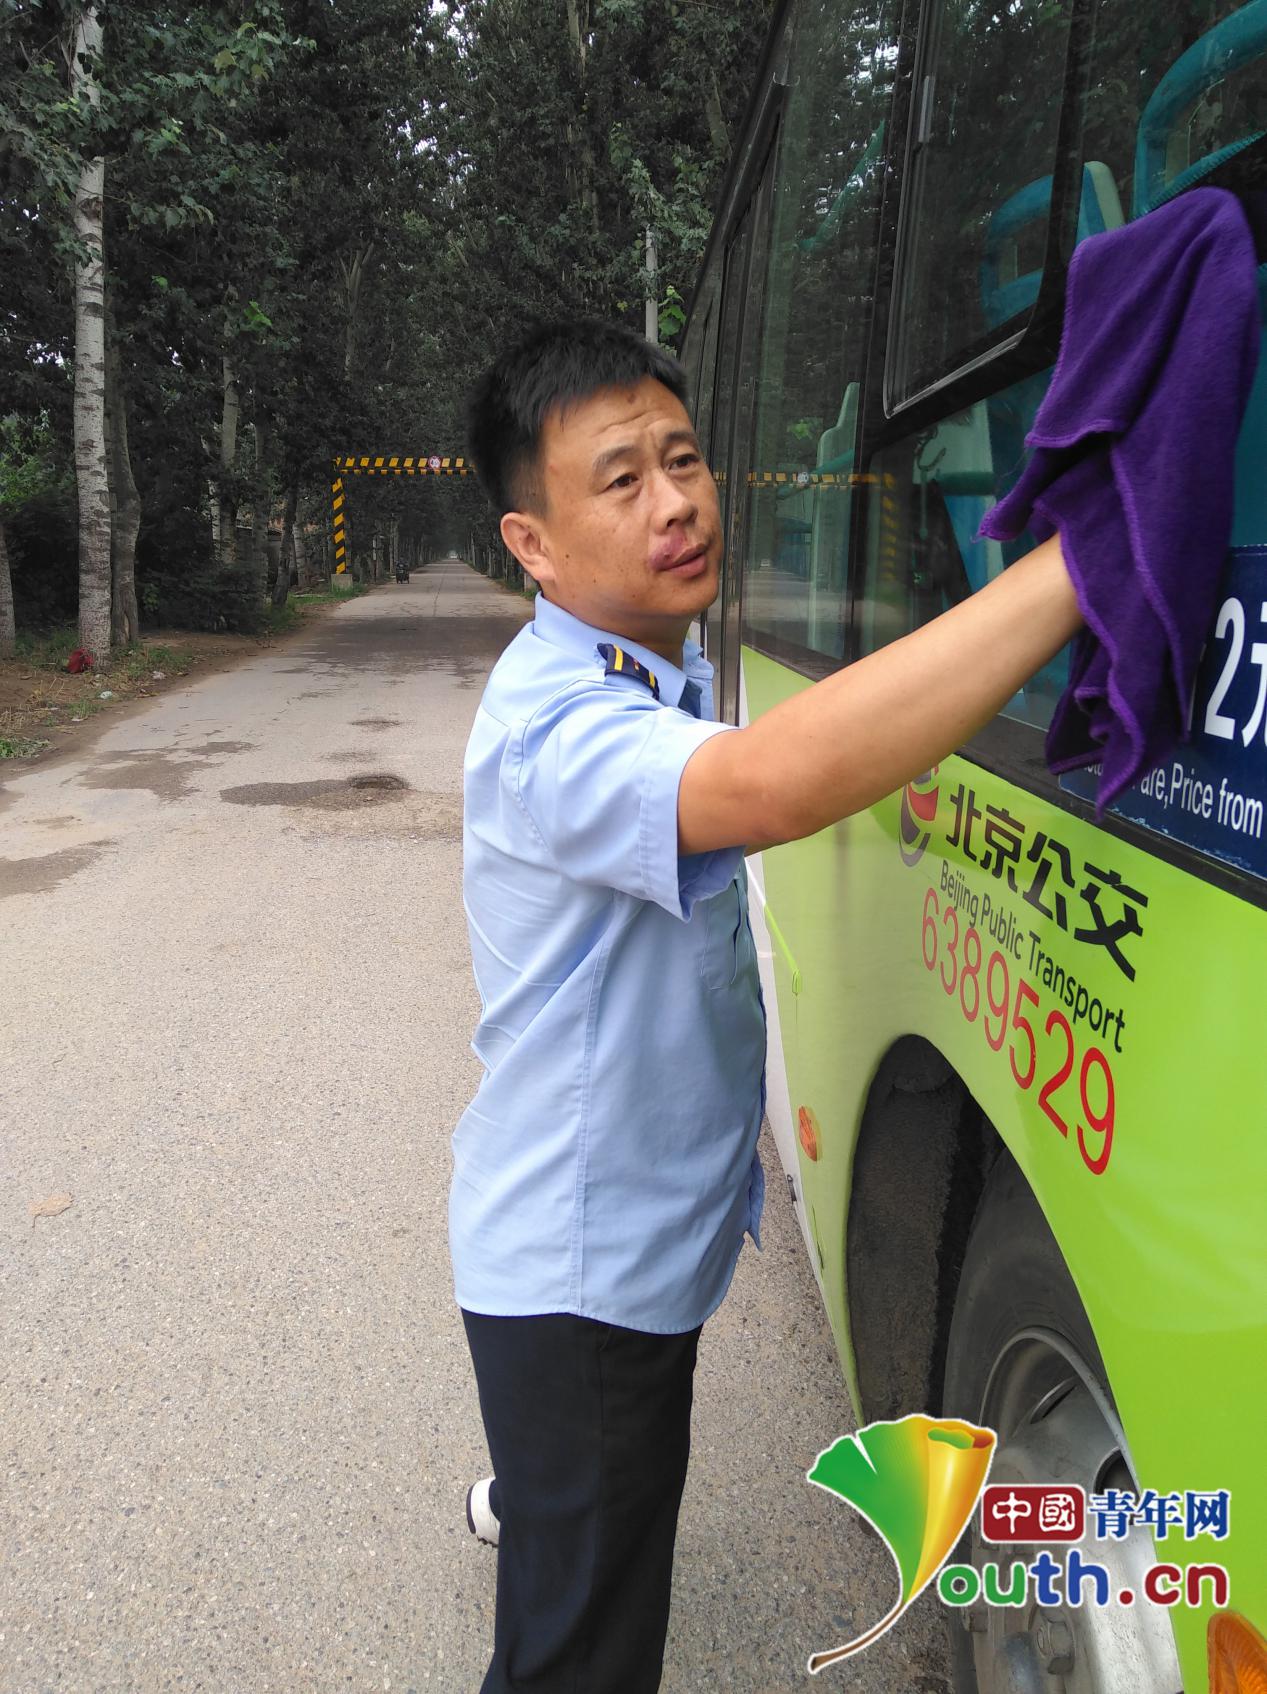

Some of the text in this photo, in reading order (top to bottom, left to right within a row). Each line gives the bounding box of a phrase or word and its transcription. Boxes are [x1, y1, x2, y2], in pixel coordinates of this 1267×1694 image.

[945, 783, 1149, 982] 北京公交
[1217, 777, 1264, 839] from
[921, 887, 1116, 1176] 6389529
[940, 859, 1126, 1053] Beijing Public Transport
